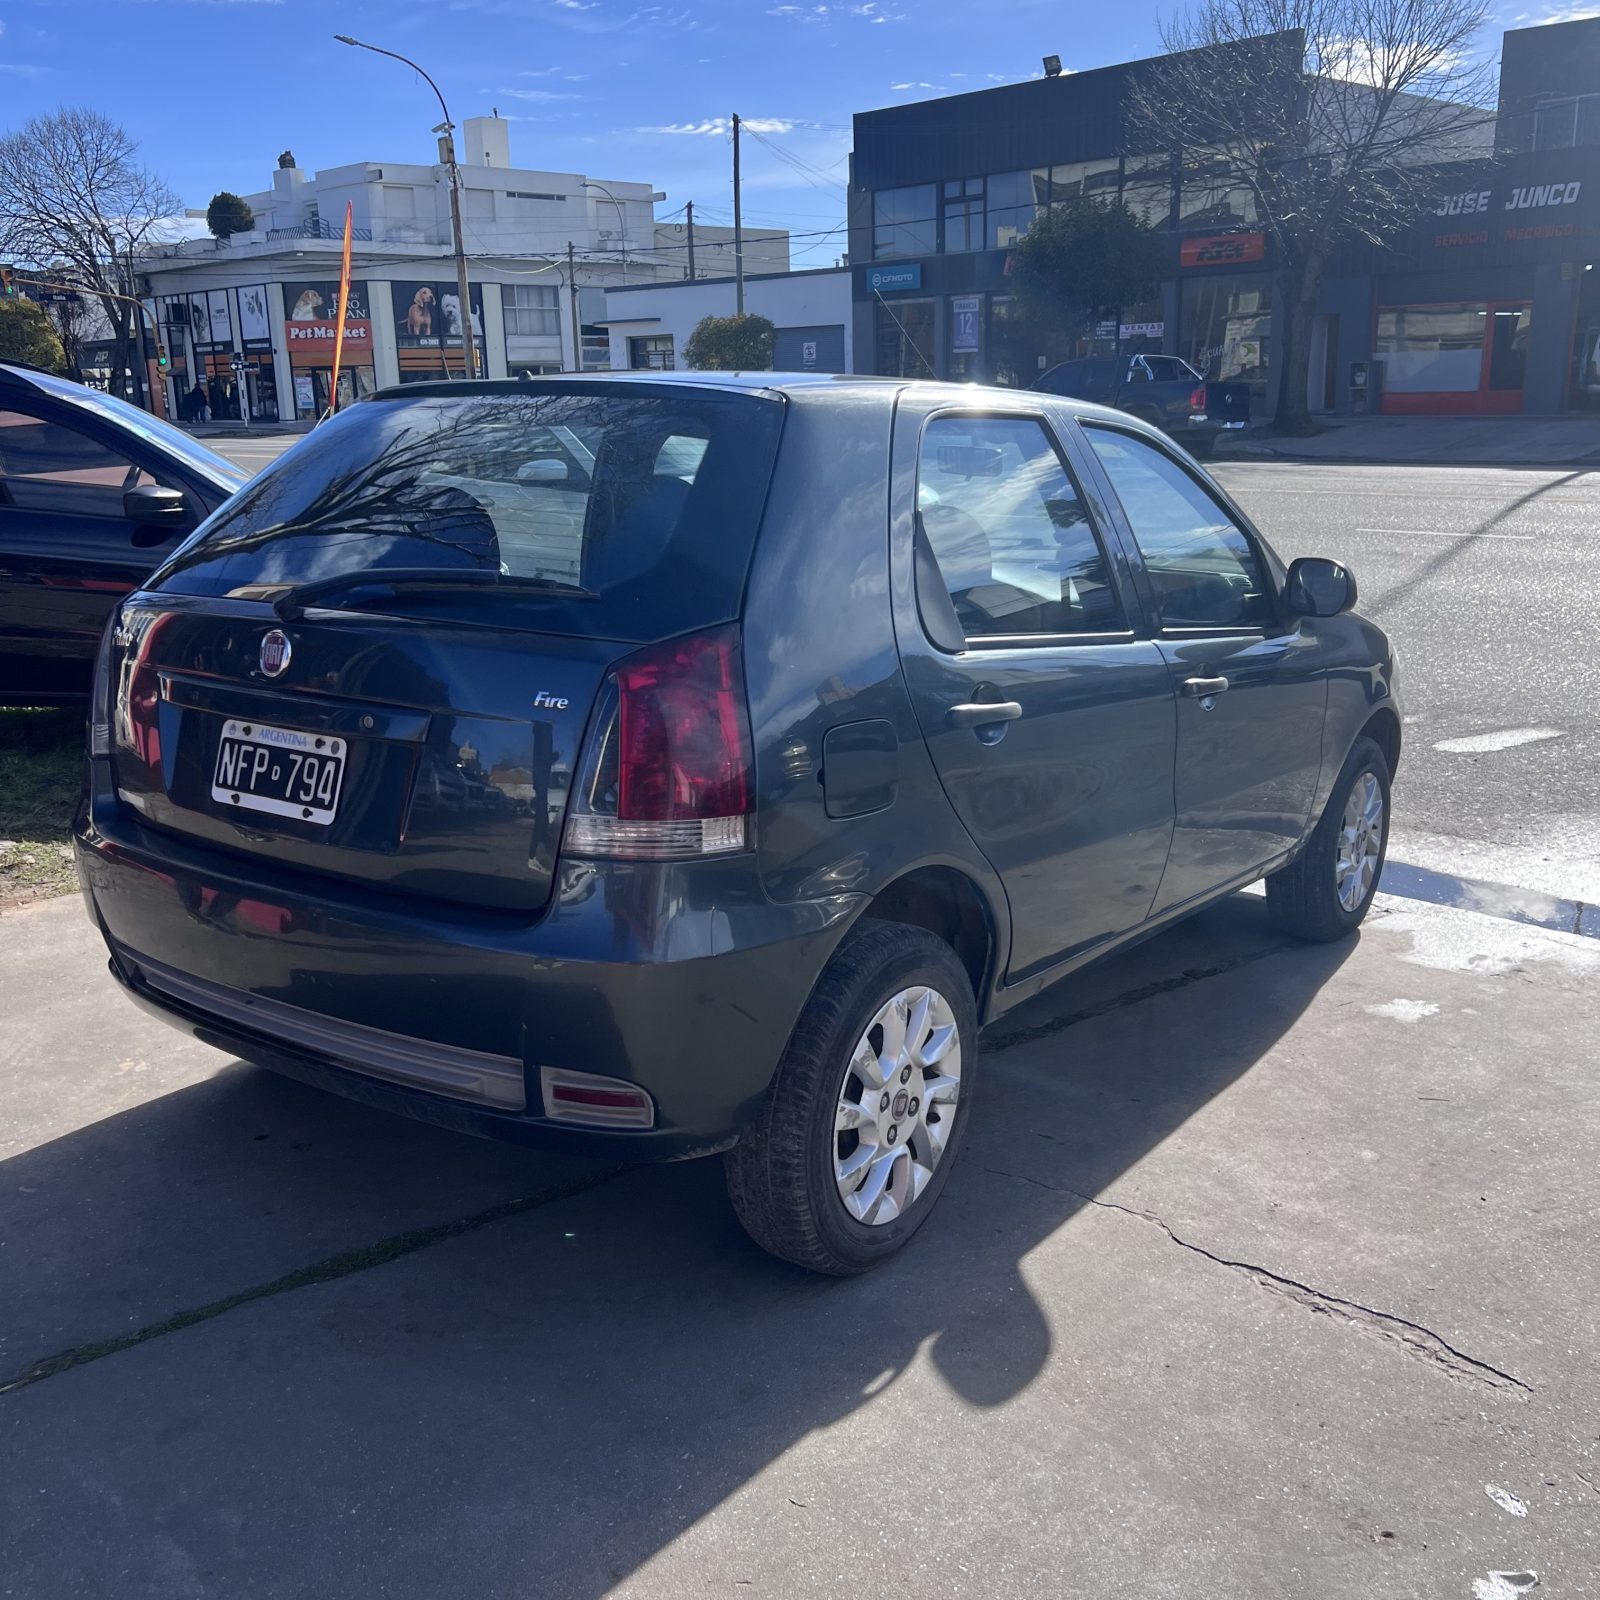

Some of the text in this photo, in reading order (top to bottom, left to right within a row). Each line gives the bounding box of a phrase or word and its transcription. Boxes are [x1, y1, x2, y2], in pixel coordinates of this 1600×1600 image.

[1436, 181, 1581, 217] JOSE JUNCO
[1433, 230, 1489, 248] SERVICIO
[327, 308, 366, 319] PAN
[960, 312, 973, 334] 12
[1124, 323, 1163, 332] VENTAS
[265, 644, 284, 665] FIAT
[533, 691, 569, 709] Fire
[258, 728, 308, 746] ARGENTINA
[218, 742, 270, 790] NFP
[285, 753, 336, 806] 794
